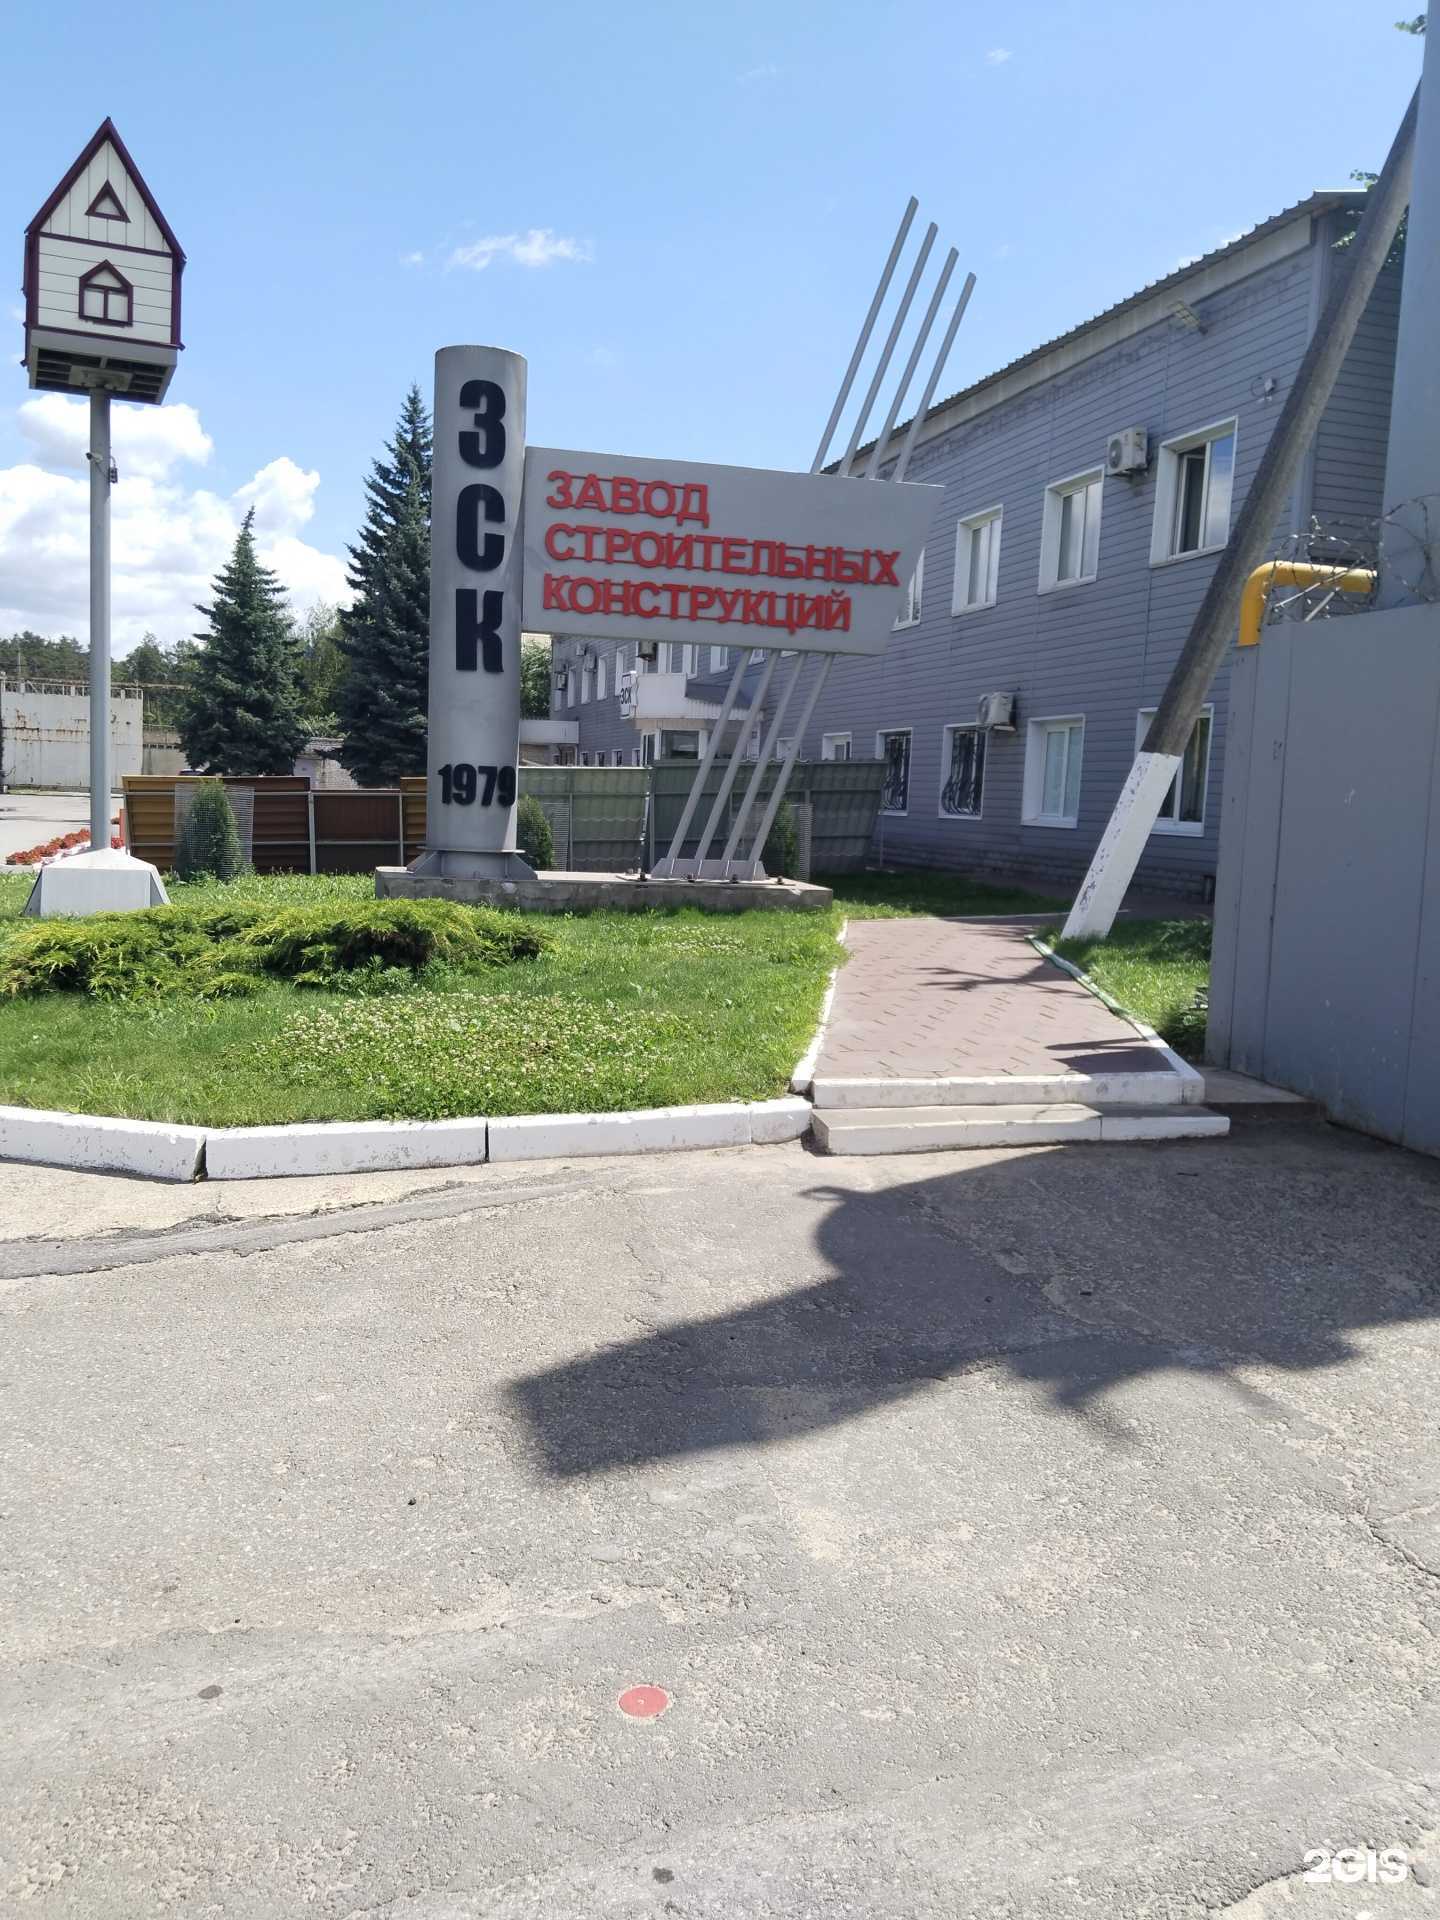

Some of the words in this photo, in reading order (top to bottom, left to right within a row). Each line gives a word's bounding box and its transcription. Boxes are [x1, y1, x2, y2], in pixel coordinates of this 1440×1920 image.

[546, 470, 709, 529] ЗАВОД
[545, 523, 901, 587] СТРОИТЕЛЬНЫХ
[543, 573, 852, 635] КОНСТРУКЦИЙ
[438, 763, 516, 807] 1979
